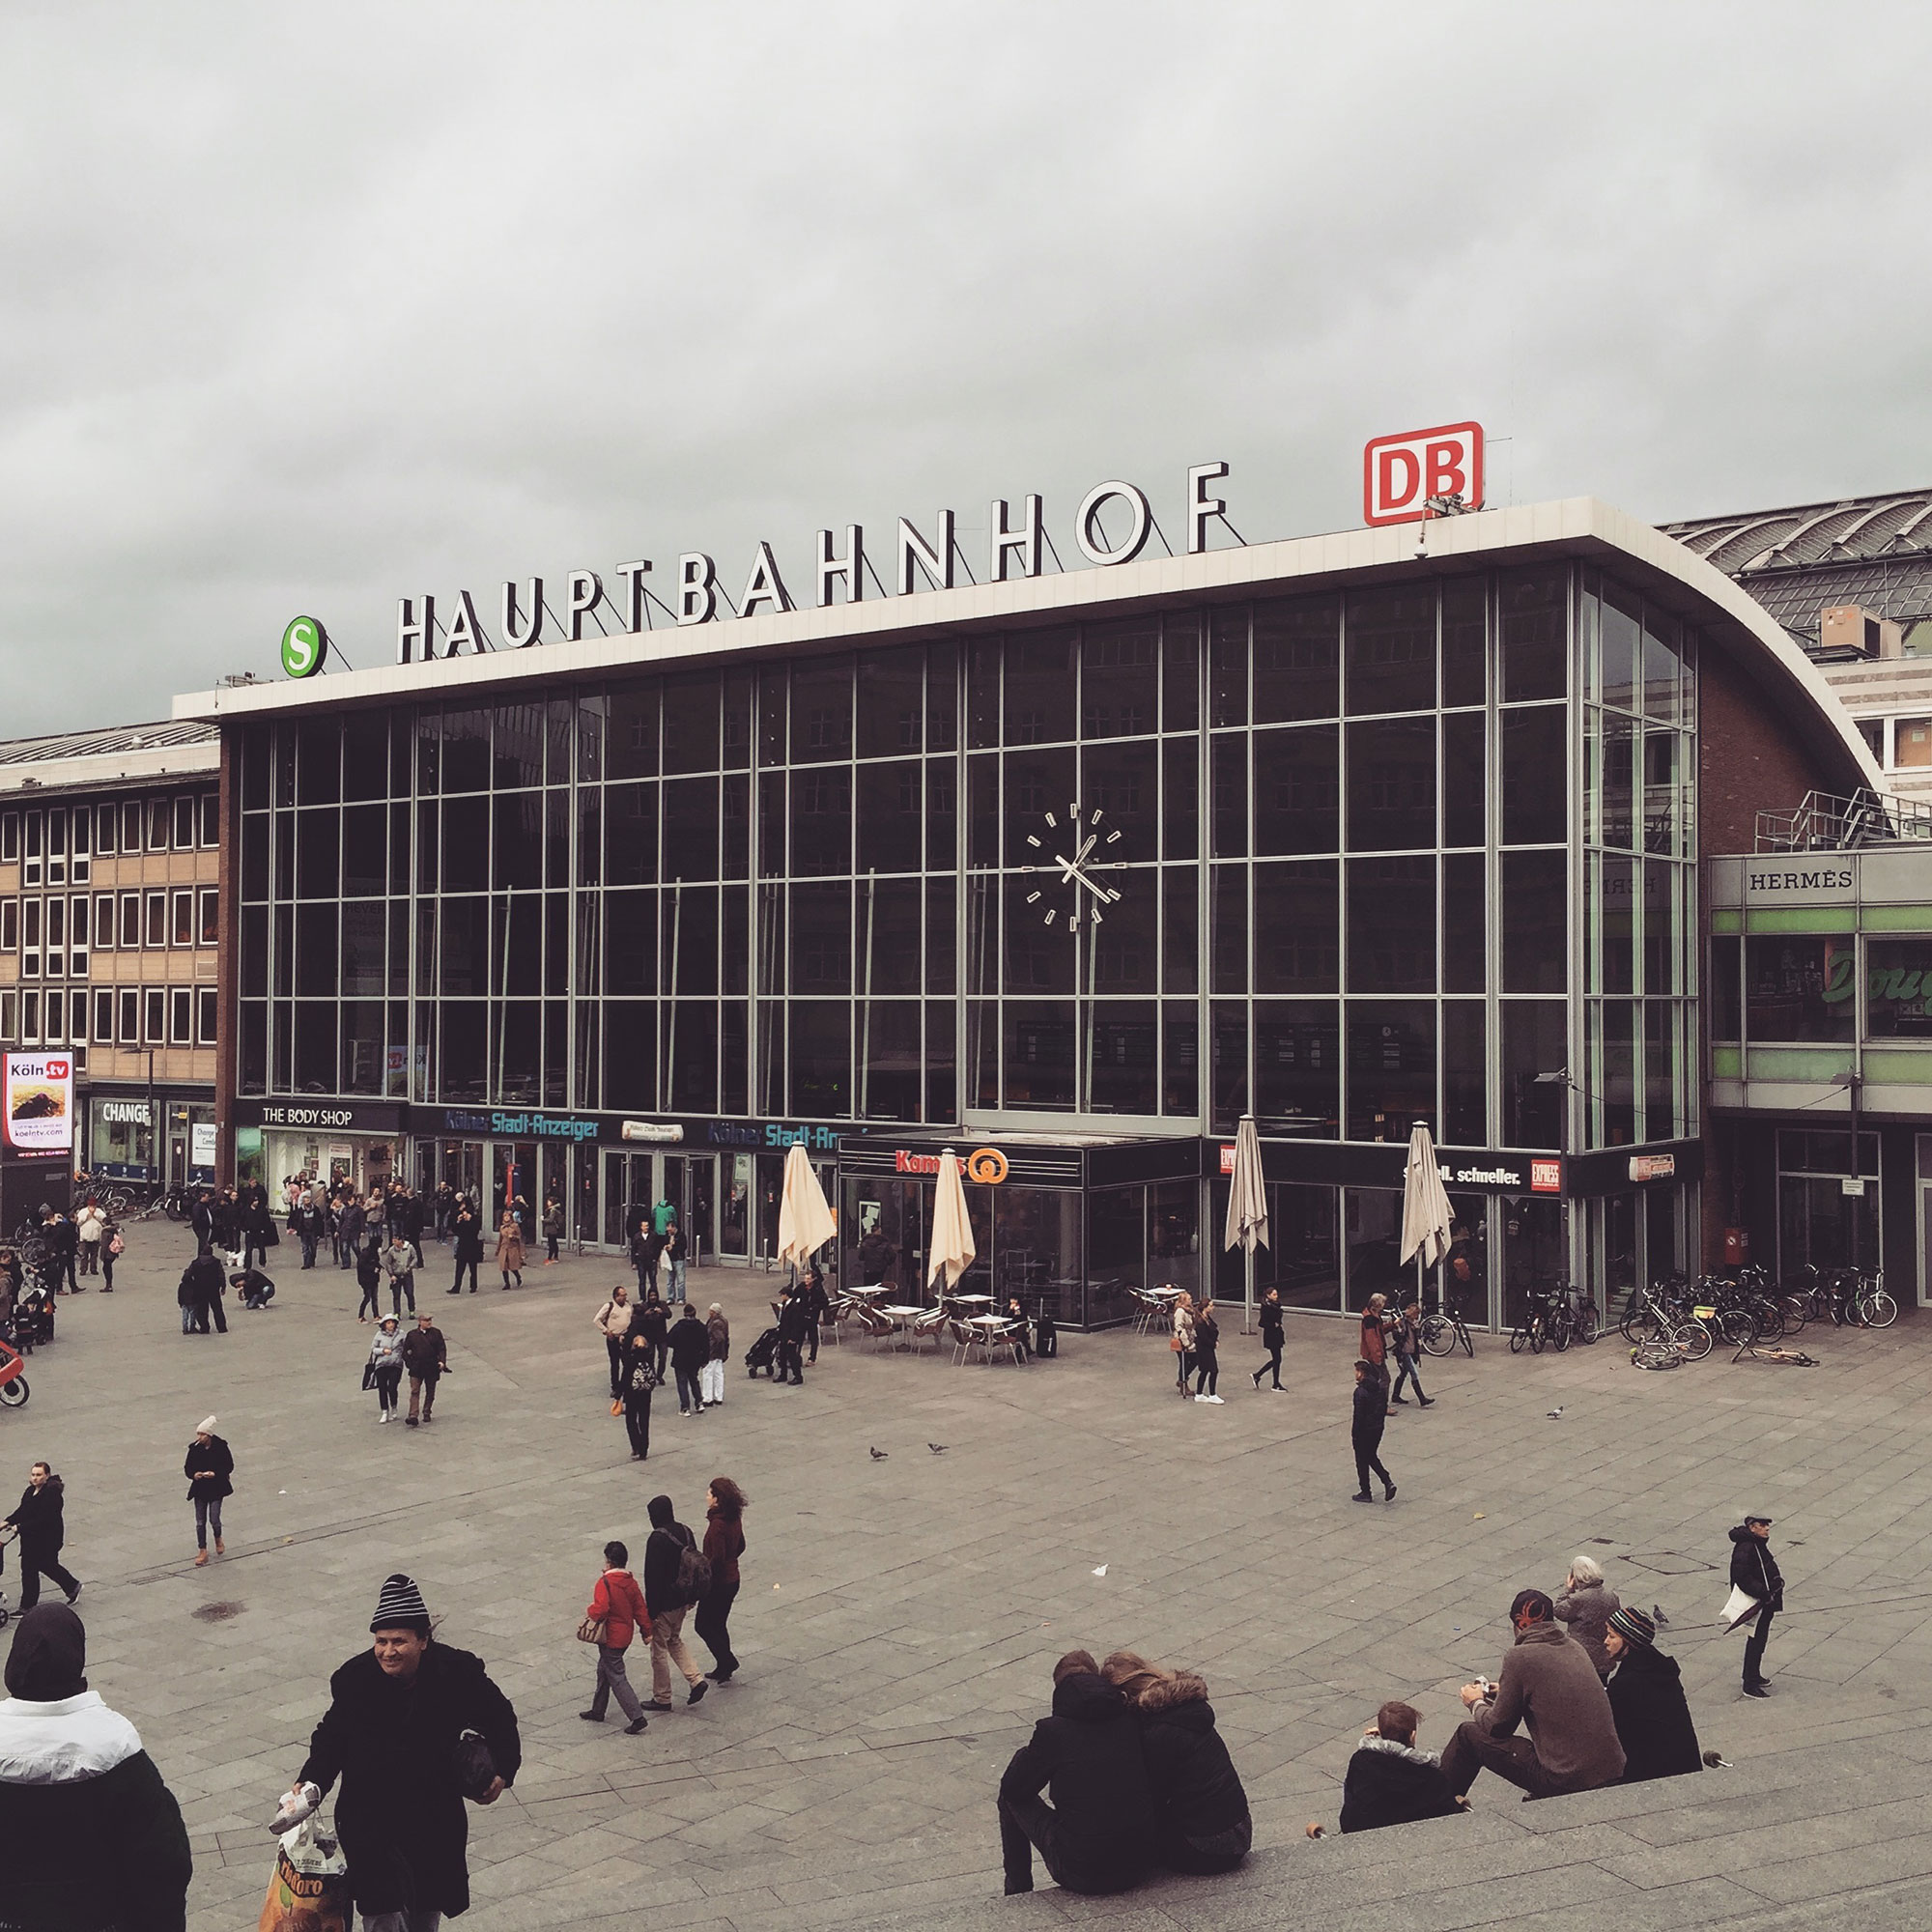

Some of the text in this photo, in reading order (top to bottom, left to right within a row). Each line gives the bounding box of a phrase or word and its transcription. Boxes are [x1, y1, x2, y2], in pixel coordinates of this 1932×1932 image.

[1379, 440, 1465, 511] DB
[397, 462, 1229, 665] HAUPTBAHNHOF
[289, 623, 312, 670] S
[102, 1102, 150, 1122] CHANGE
[263, 1107, 353, 1125] THE BODY SHOP
[491, 1112, 599, 1141] Stadt-Anzeiger
[895, 1150, 966, 1176] Kams
[1457, 1167, 1521, 1185] schneller.
